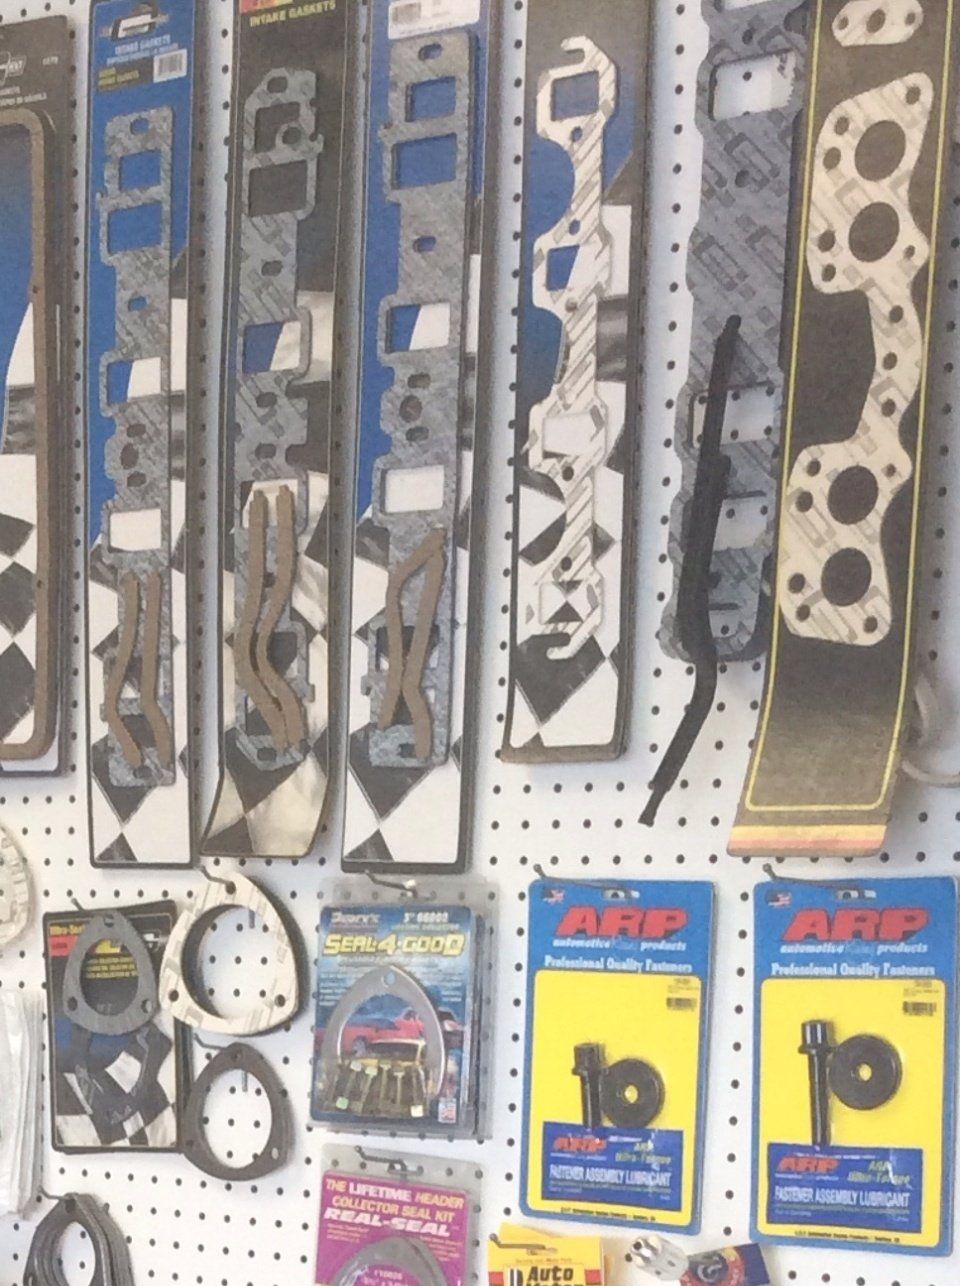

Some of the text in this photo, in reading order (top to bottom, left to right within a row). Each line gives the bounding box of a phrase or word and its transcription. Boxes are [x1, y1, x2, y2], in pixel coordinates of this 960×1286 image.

[249, 1, 336, 27] INTAKE GASKETS
[555, 905, 688, 939] ARP
[783, 907, 930, 943] ARP
[640, 939, 687, 951] products
[876, 943, 929, 956] products
[544, 954, 693, 974] Professional Quality Fasteners
[771, 961, 936, 979] Professional Quality Fasteners
[549, 1163, 672, 1188] FASTENER ASSEMBLY LUBRICANT
[778, 1156, 840, 1173] ARP
[325, 1178, 465, 1210] THE LIFETIME HEADER
[774, 1184, 911, 1208] FASTENER ASSEMBLY LUBRICANT
[331, 1194, 456, 1223] COLLECTOR SEAL KIT
[323, 1206, 452, 1238] REAL-SEAL
[527, 1265, 575, 1282] Auto
